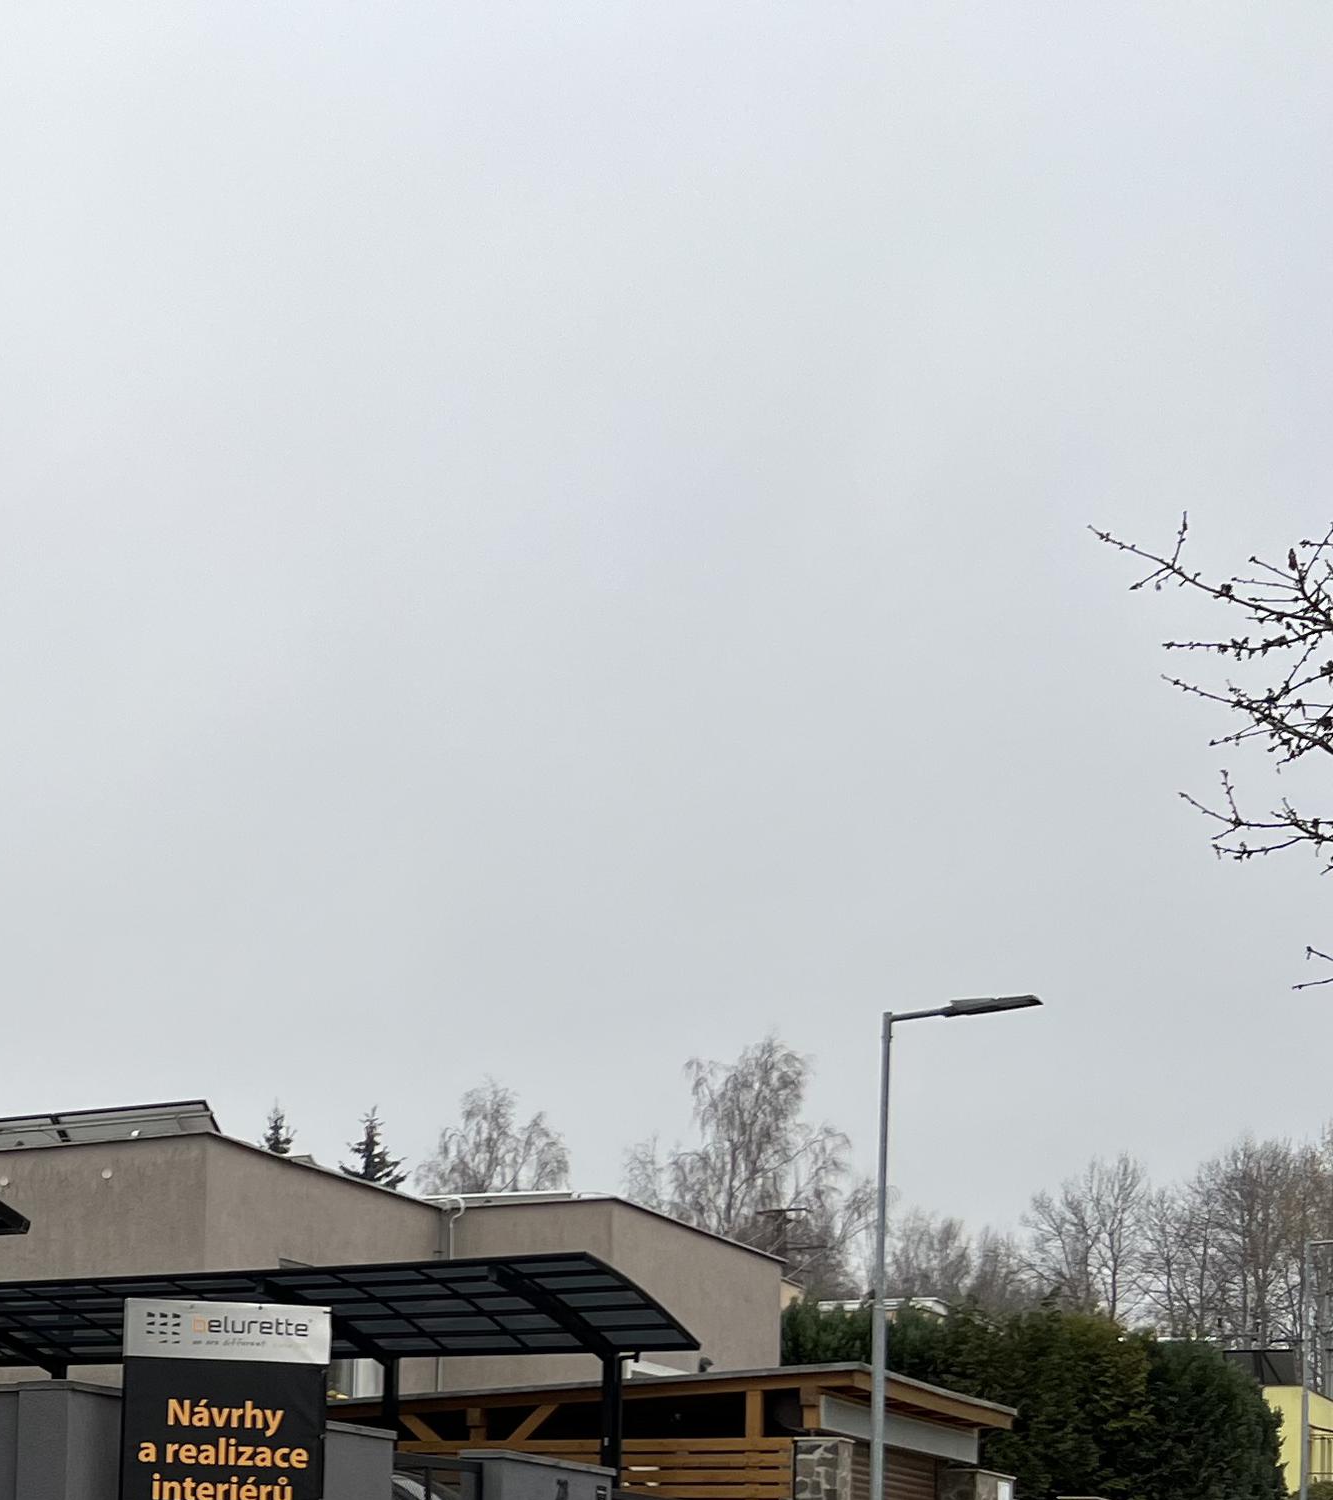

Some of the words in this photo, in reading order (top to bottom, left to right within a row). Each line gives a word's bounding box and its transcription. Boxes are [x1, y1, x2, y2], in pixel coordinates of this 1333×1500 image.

[166, 1399, 284, 1437] Návrhy
[137, 1441, 158, 1463] a
[165, 1437, 309, 1469] realizace
